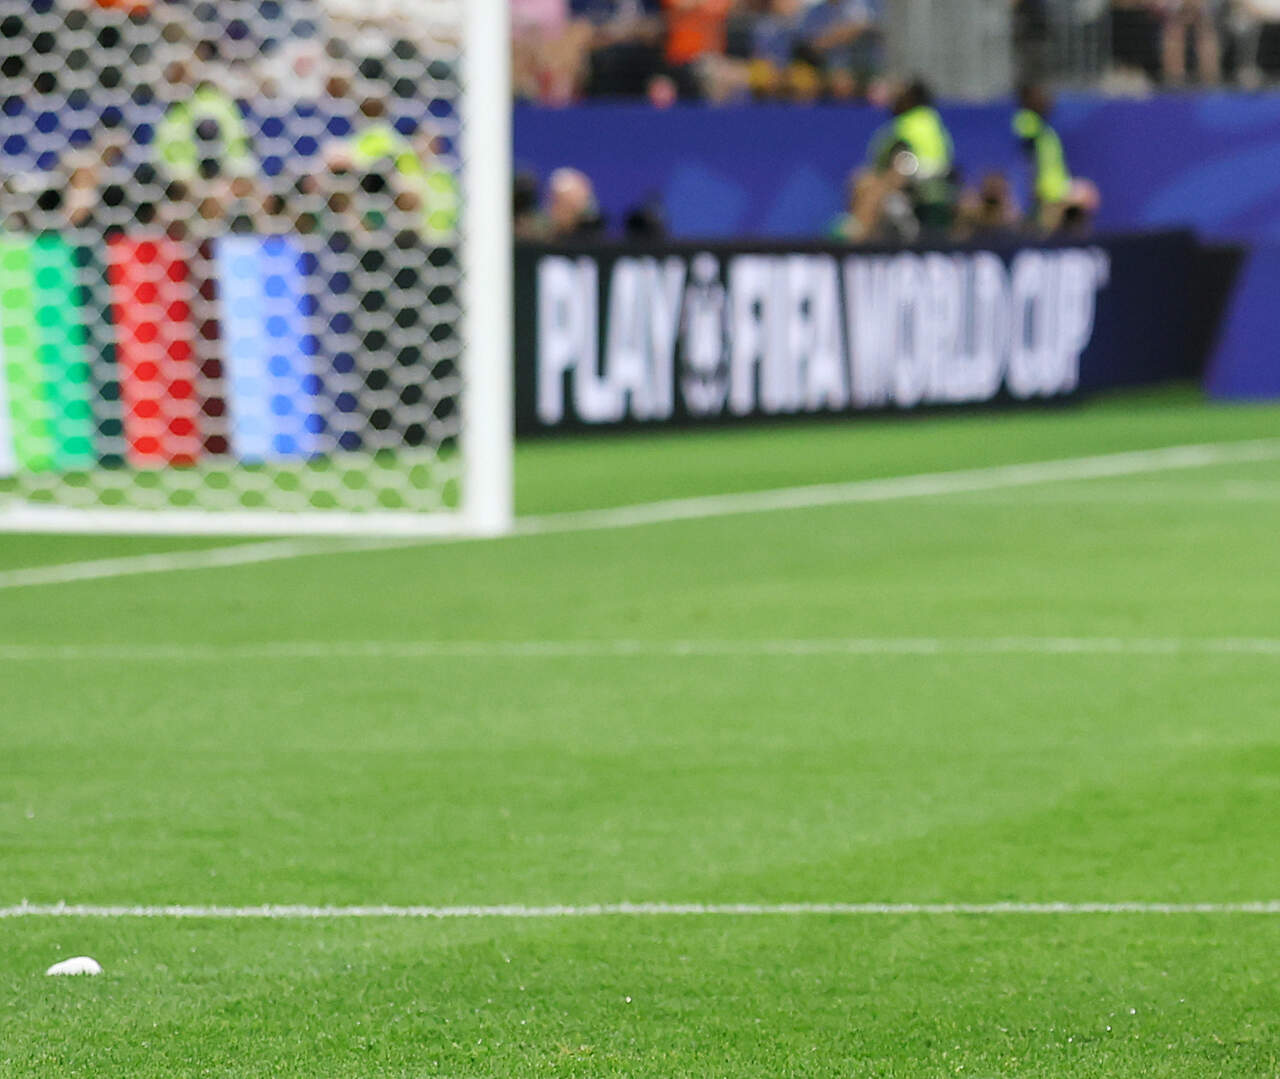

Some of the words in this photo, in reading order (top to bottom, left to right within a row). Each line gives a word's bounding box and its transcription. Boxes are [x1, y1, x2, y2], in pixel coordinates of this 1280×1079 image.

[537, 254, 687, 424] PLAY
[727, 252, 849, 416] FIFA
[843, 250, 1005, 409] WORLD
